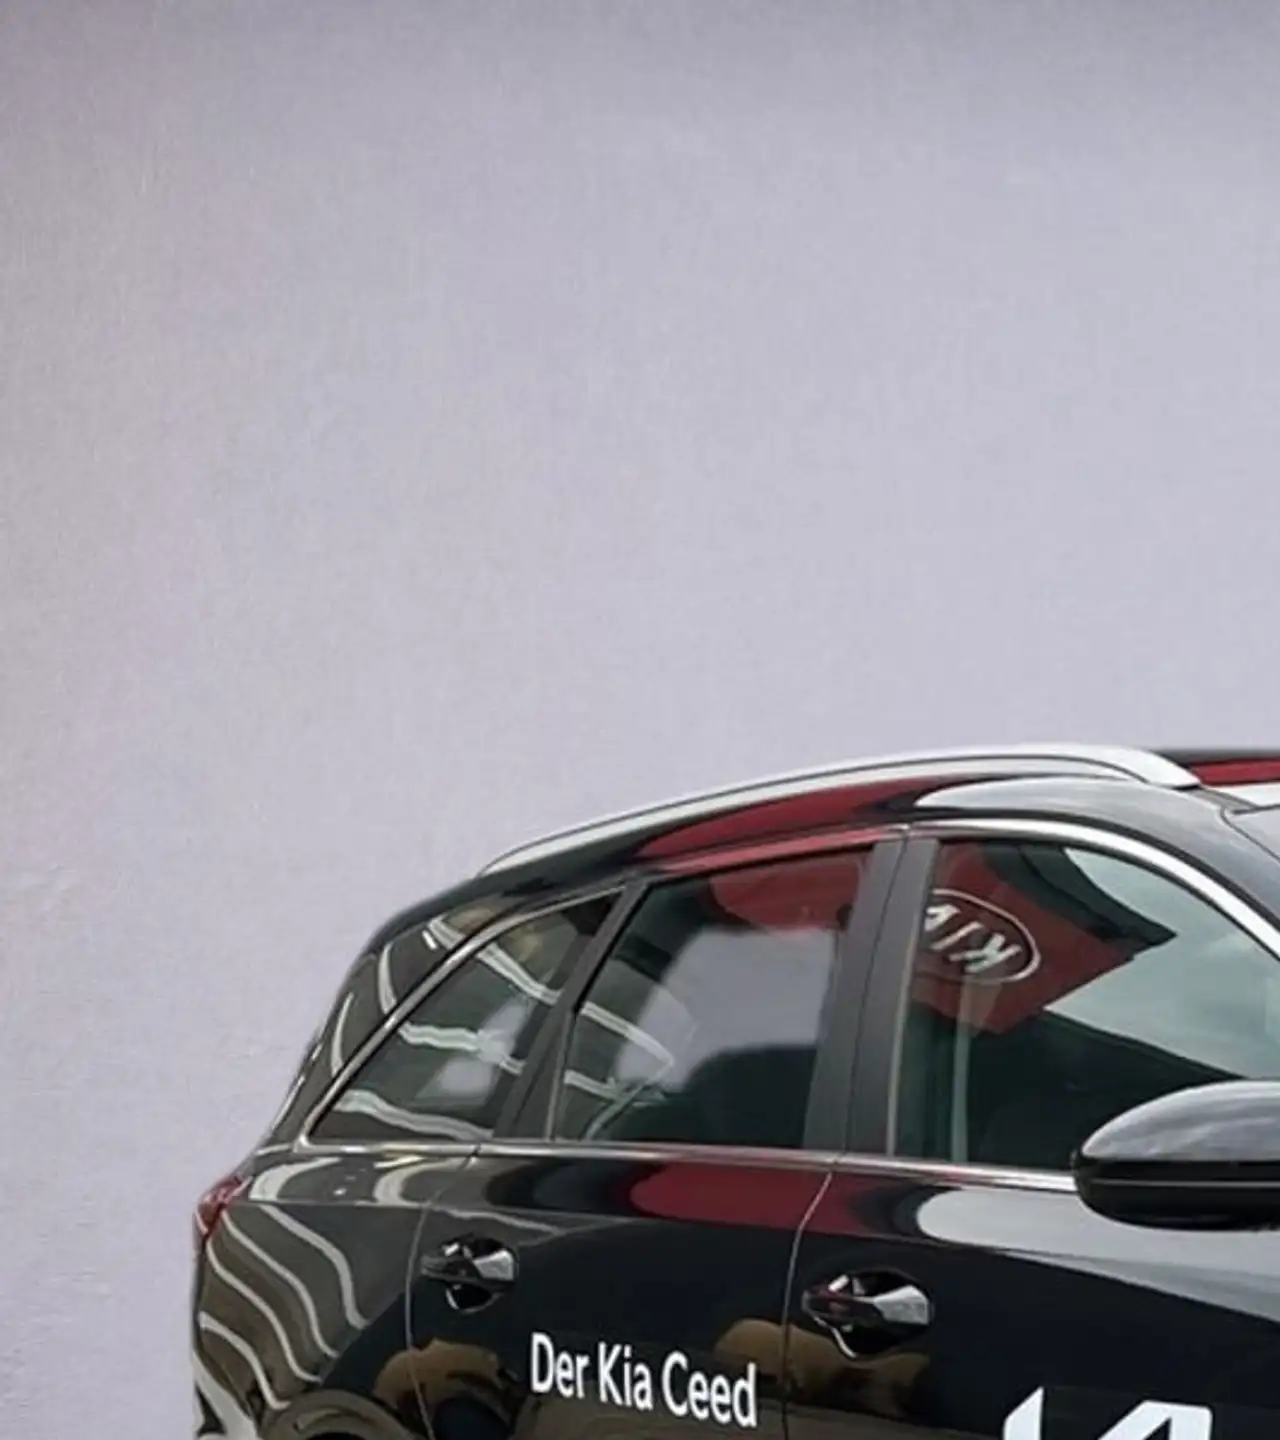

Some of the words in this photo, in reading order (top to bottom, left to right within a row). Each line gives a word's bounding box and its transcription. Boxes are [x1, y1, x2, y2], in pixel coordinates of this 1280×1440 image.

[531, 1332, 590, 1400] Der
[598, 1342, 654, 1411] Kia
[661, 1351, 757, 1428] Ceed
